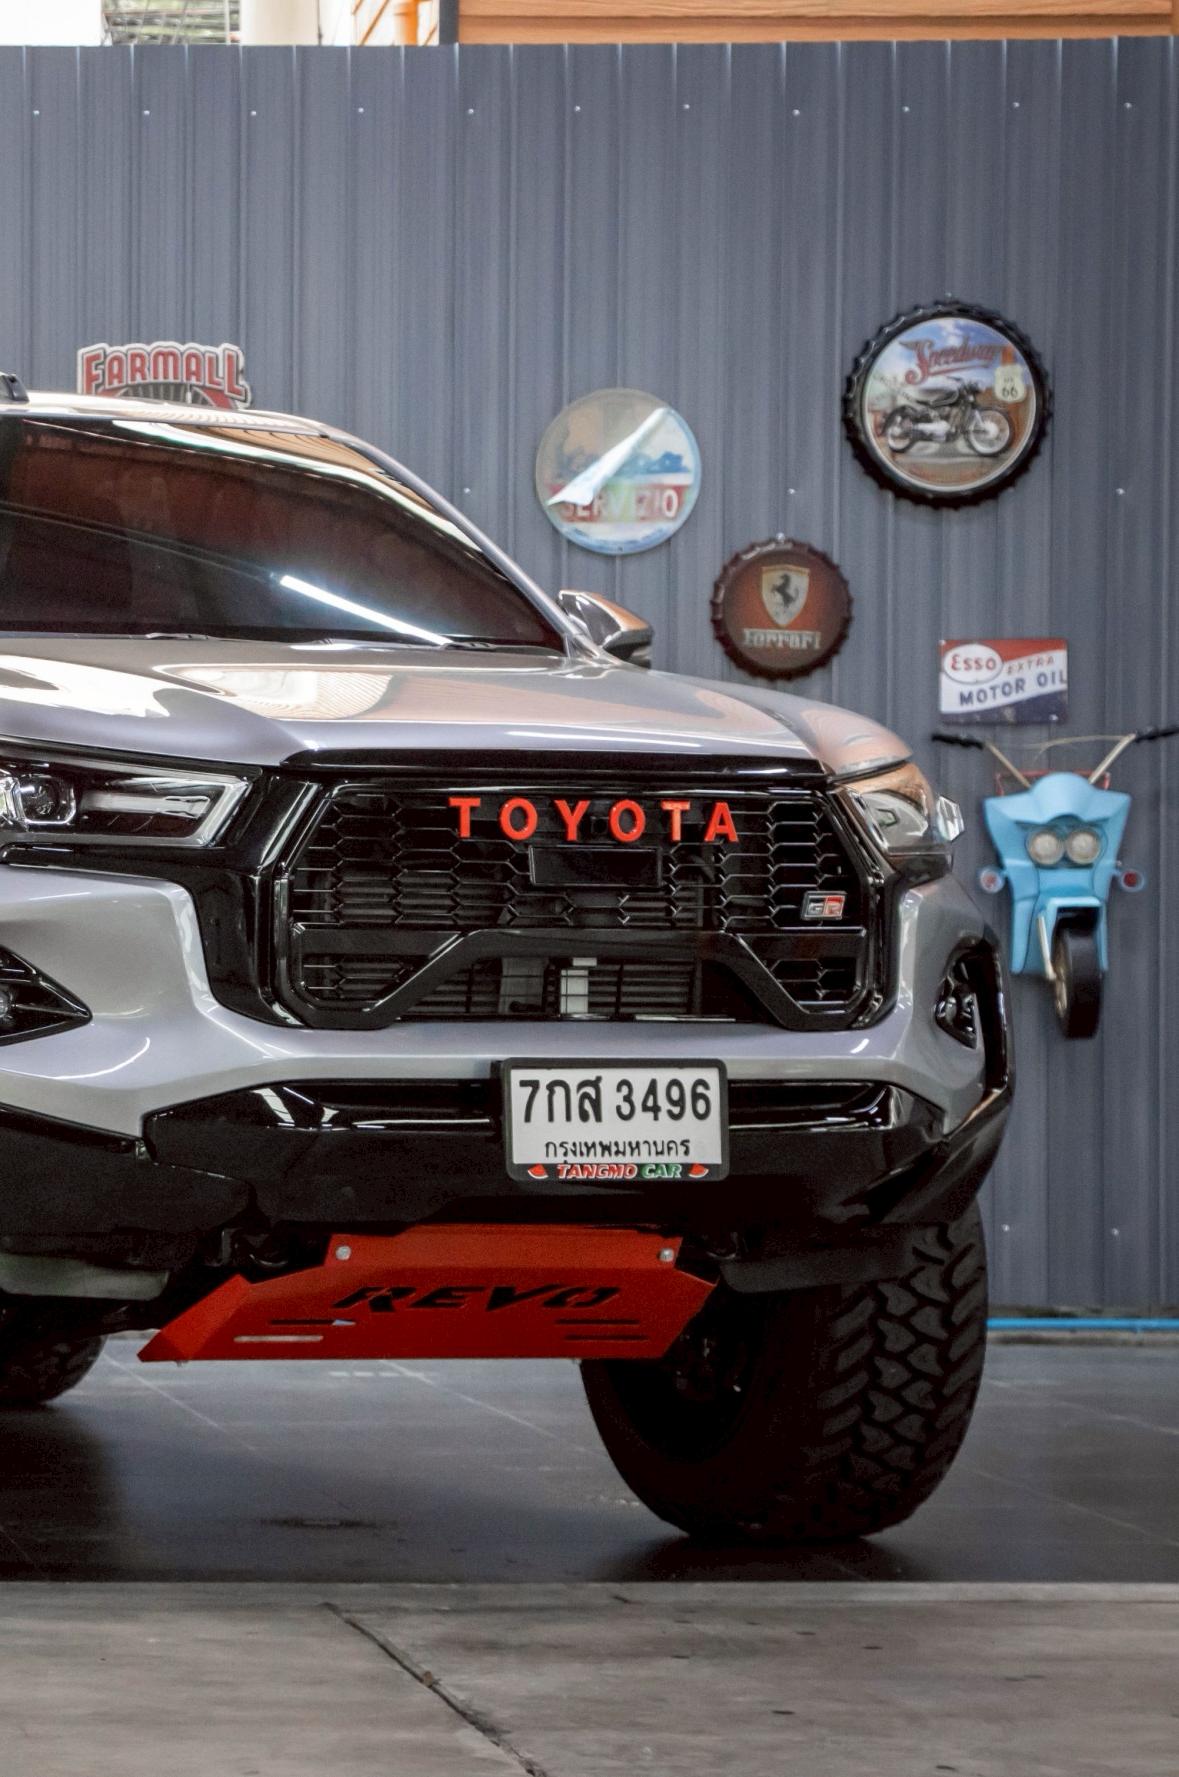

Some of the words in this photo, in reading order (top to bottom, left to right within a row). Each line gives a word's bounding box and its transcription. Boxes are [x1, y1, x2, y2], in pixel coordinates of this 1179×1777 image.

[82, 347, 247, 398] FARMALL
[1001, 386, 1019, 398] 66
[743, 628, 821, 650] Ferrari
[1007, 654, 1055, 675] EXTRA
[959, 677, 1026, 706] MOTOR
[1036, 669, 1067, 688] OIL
[448, 797, 738, 843] TOYOTA
[519, 1075, 603, 1123] 7กส
[615, 1078, 711, 1122] 3496
[545, 1138, 691, 1165] กรุงเทพมหานคร
[557, 1163, 638, 1179] TANGMO
[641, 1163, 682, 1179] CAR
[331, 1284, 621, 1313] REVO
